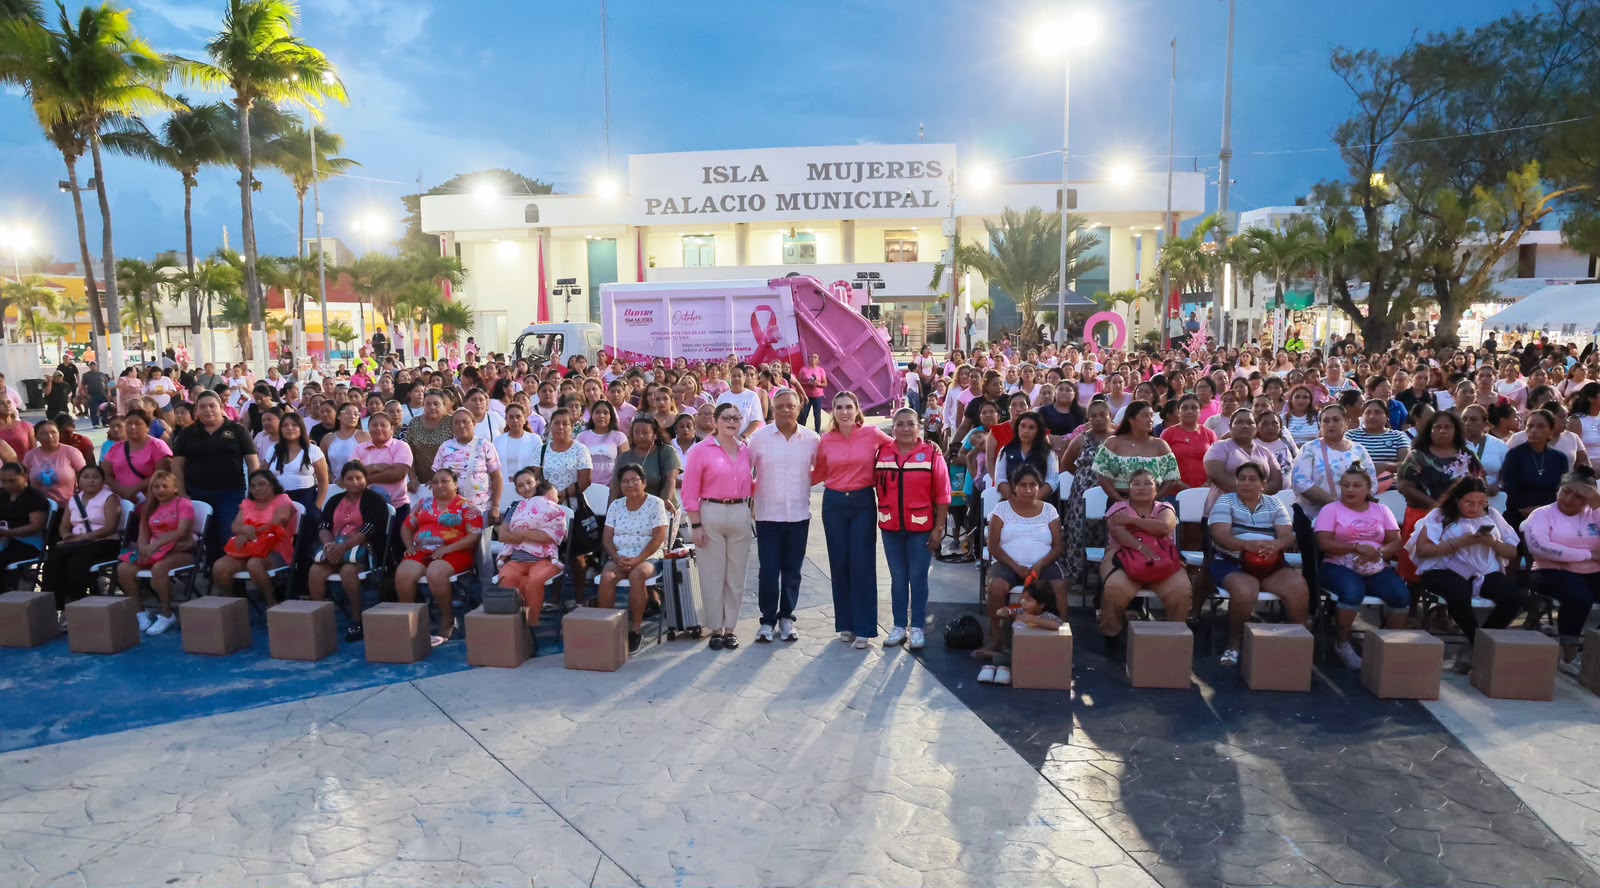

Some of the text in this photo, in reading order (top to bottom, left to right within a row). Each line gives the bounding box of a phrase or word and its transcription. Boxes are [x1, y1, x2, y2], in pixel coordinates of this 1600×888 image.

[702, 160, 943, 184] ISLA MUJERES
[645, 190, 939, 216] PALACIO MUNICIPAL
